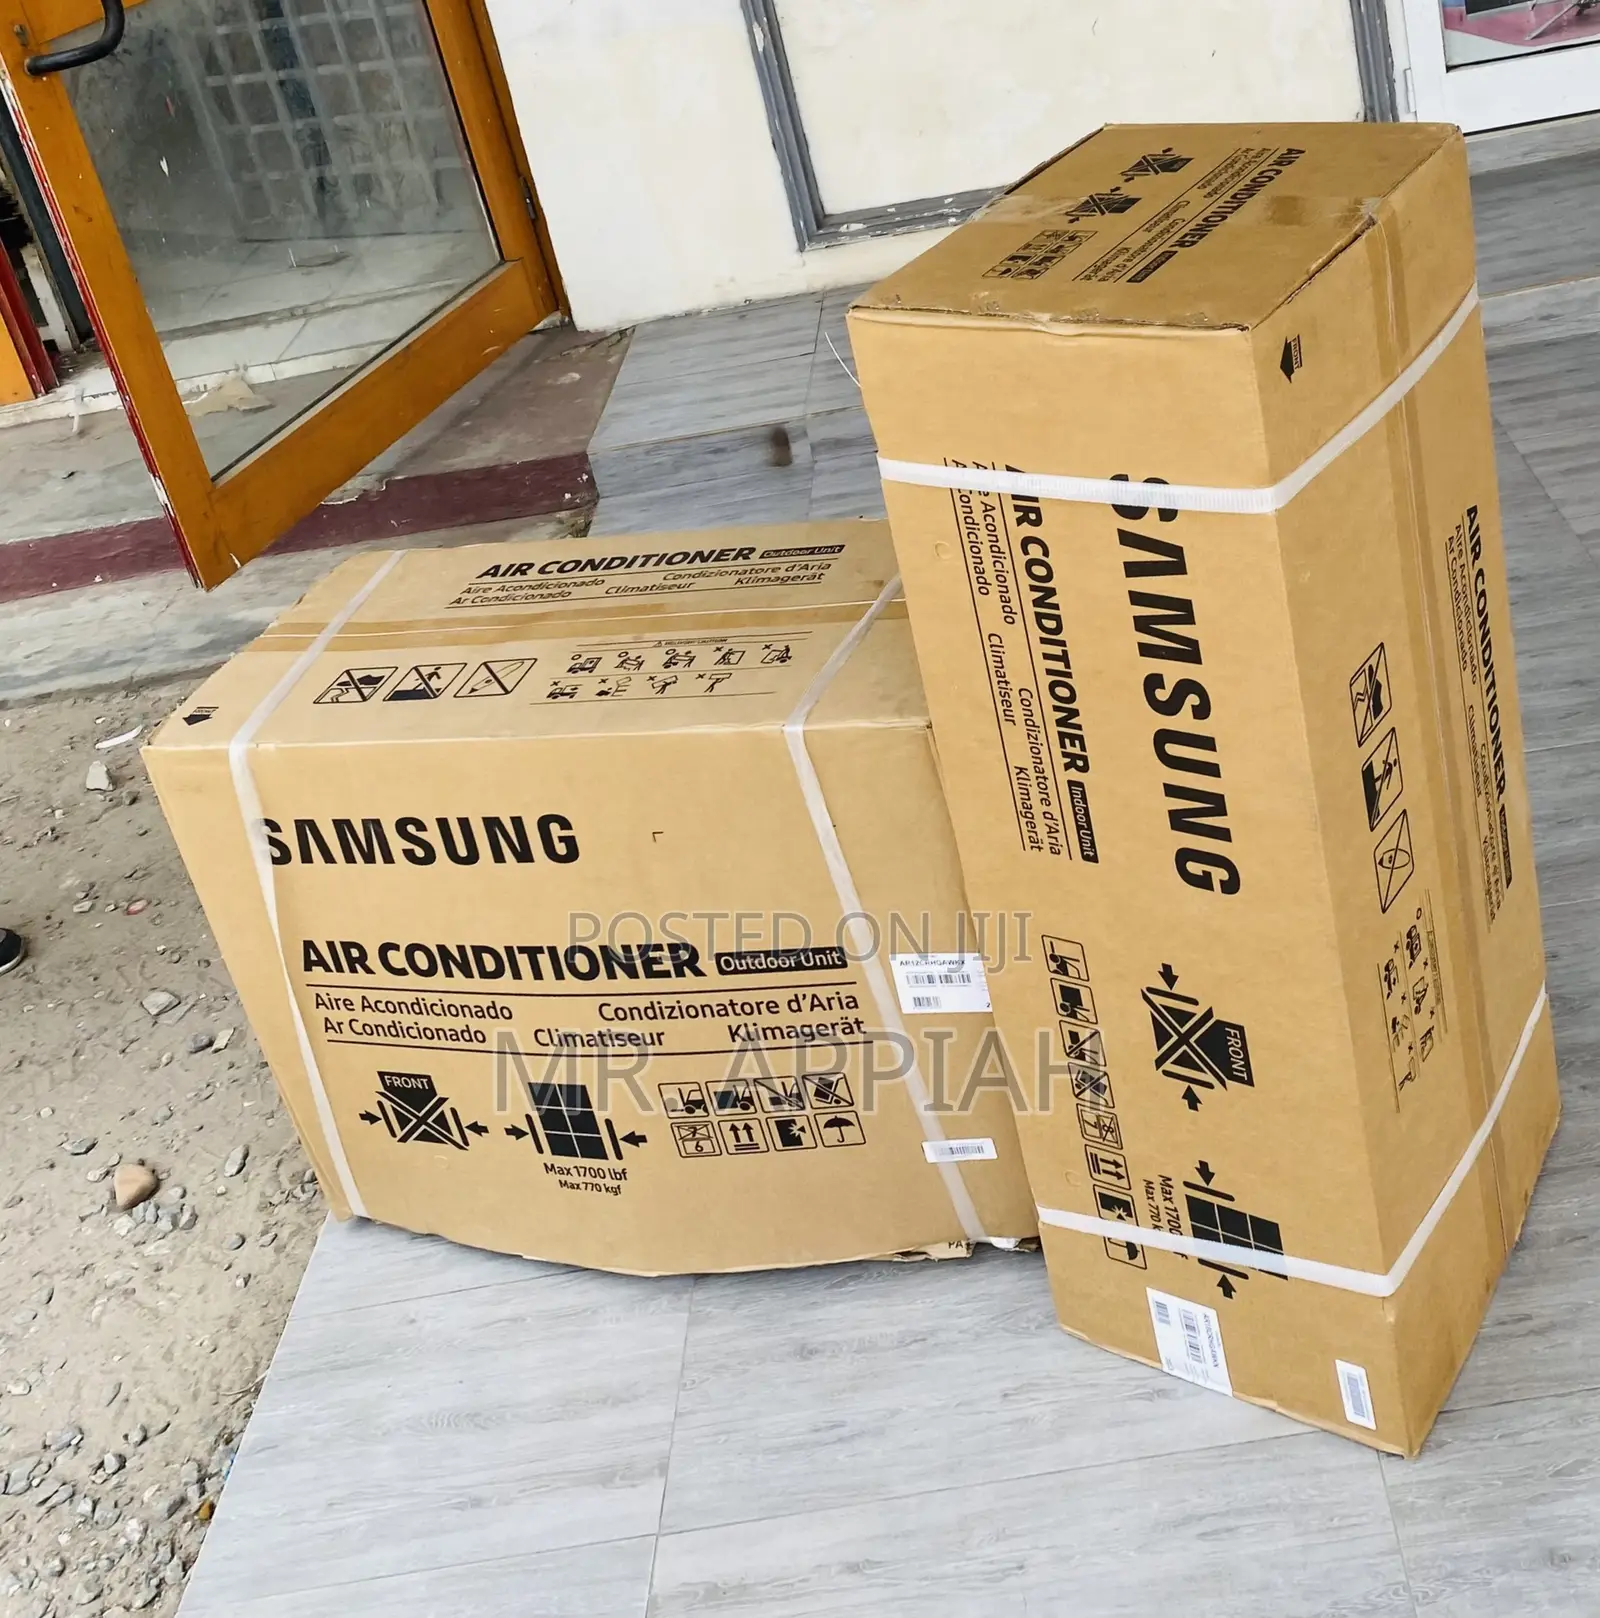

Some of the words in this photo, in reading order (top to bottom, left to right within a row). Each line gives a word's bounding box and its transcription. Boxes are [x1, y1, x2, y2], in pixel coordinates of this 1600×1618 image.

[1267, 148, 1306, 167] AIR
[1168, 168, 1283, 248] CONDITIONER
[763, 547, 812, 559] Outdoor
[814, 546, 842, 555] Unit
[957, 488, 989, 597] ondicionado
[476, 562, 535, 579] AIR
[537, 547, 756, 576] CONDITIONER
[663, 565, 781, 580] Condizionatore
[785, 562, 832, 572] d'Aria
[980, 500, 1016, 625] Acondicionado
[460, 584, 492, 594] Aire
[493, 578, 605, 593] Acondicionado
[605, 582, 696, 595] Climatiseur
[734, 573, 826, 586] Klimagerät
[448, 596, 466, 605] Ar
[470, 591, 571, 604] Condicionado
[1020, 535, 1090, 774] CONDITIONER
[1466, 505, 1482, 569] AIR
[1474, 568, 1506, 802] CONDITIONER
[987, 632, 1017, 726] Climatiseur
[1018, 688, 1053, 808] Condizionatore
[1042, 809, 1061, 855] d'Aria
[1014, 765, 1043, 852] Klimagerät
[1071, 786, 1087, 828] Indoor
[1079, 829, 1095, 857] Unit
[262, 814, 580, 866] SAMSUNG
[303, 940, 376, 974] AIR
[377, 941, 707, 981] CONDITIONER
[719, 952, 797, 972] Outdoor
[801, 949, 842, 968] Unit
[314, 992, 355, 1012] Aire
[361, 994, 513, 1021] Acondicionado
[598, 997, 780, 1022] Condizionatore
[786, 991, 860, 1014] d'Aria
[323, 1016, 344, 1036] Ar
[348, 1019, 486, 1044] Condicionado
[533, 1028, 665, 1048] Climatiseur
[728, 1017, 867, 1044] Klimagerät
[1224, 1027, 1248, 1081] FRONT
[384, 1075, 430, 1092] FRONT
[543, 1163, 573, 1178] Max
[573, 1165, 606, 1181] 1700
[607, 1166, 628, 1182] lbf
[558, 1179, 581, 1191] Max
[581, 1182, 601, 1193] 770
[602, 1182, 622, 1196] kgf
[1143, 1179, 1155, 1202] Max
[1158, 1175, 1174, 1204] Max
[1148, 1202, 1161, 1223] 770
